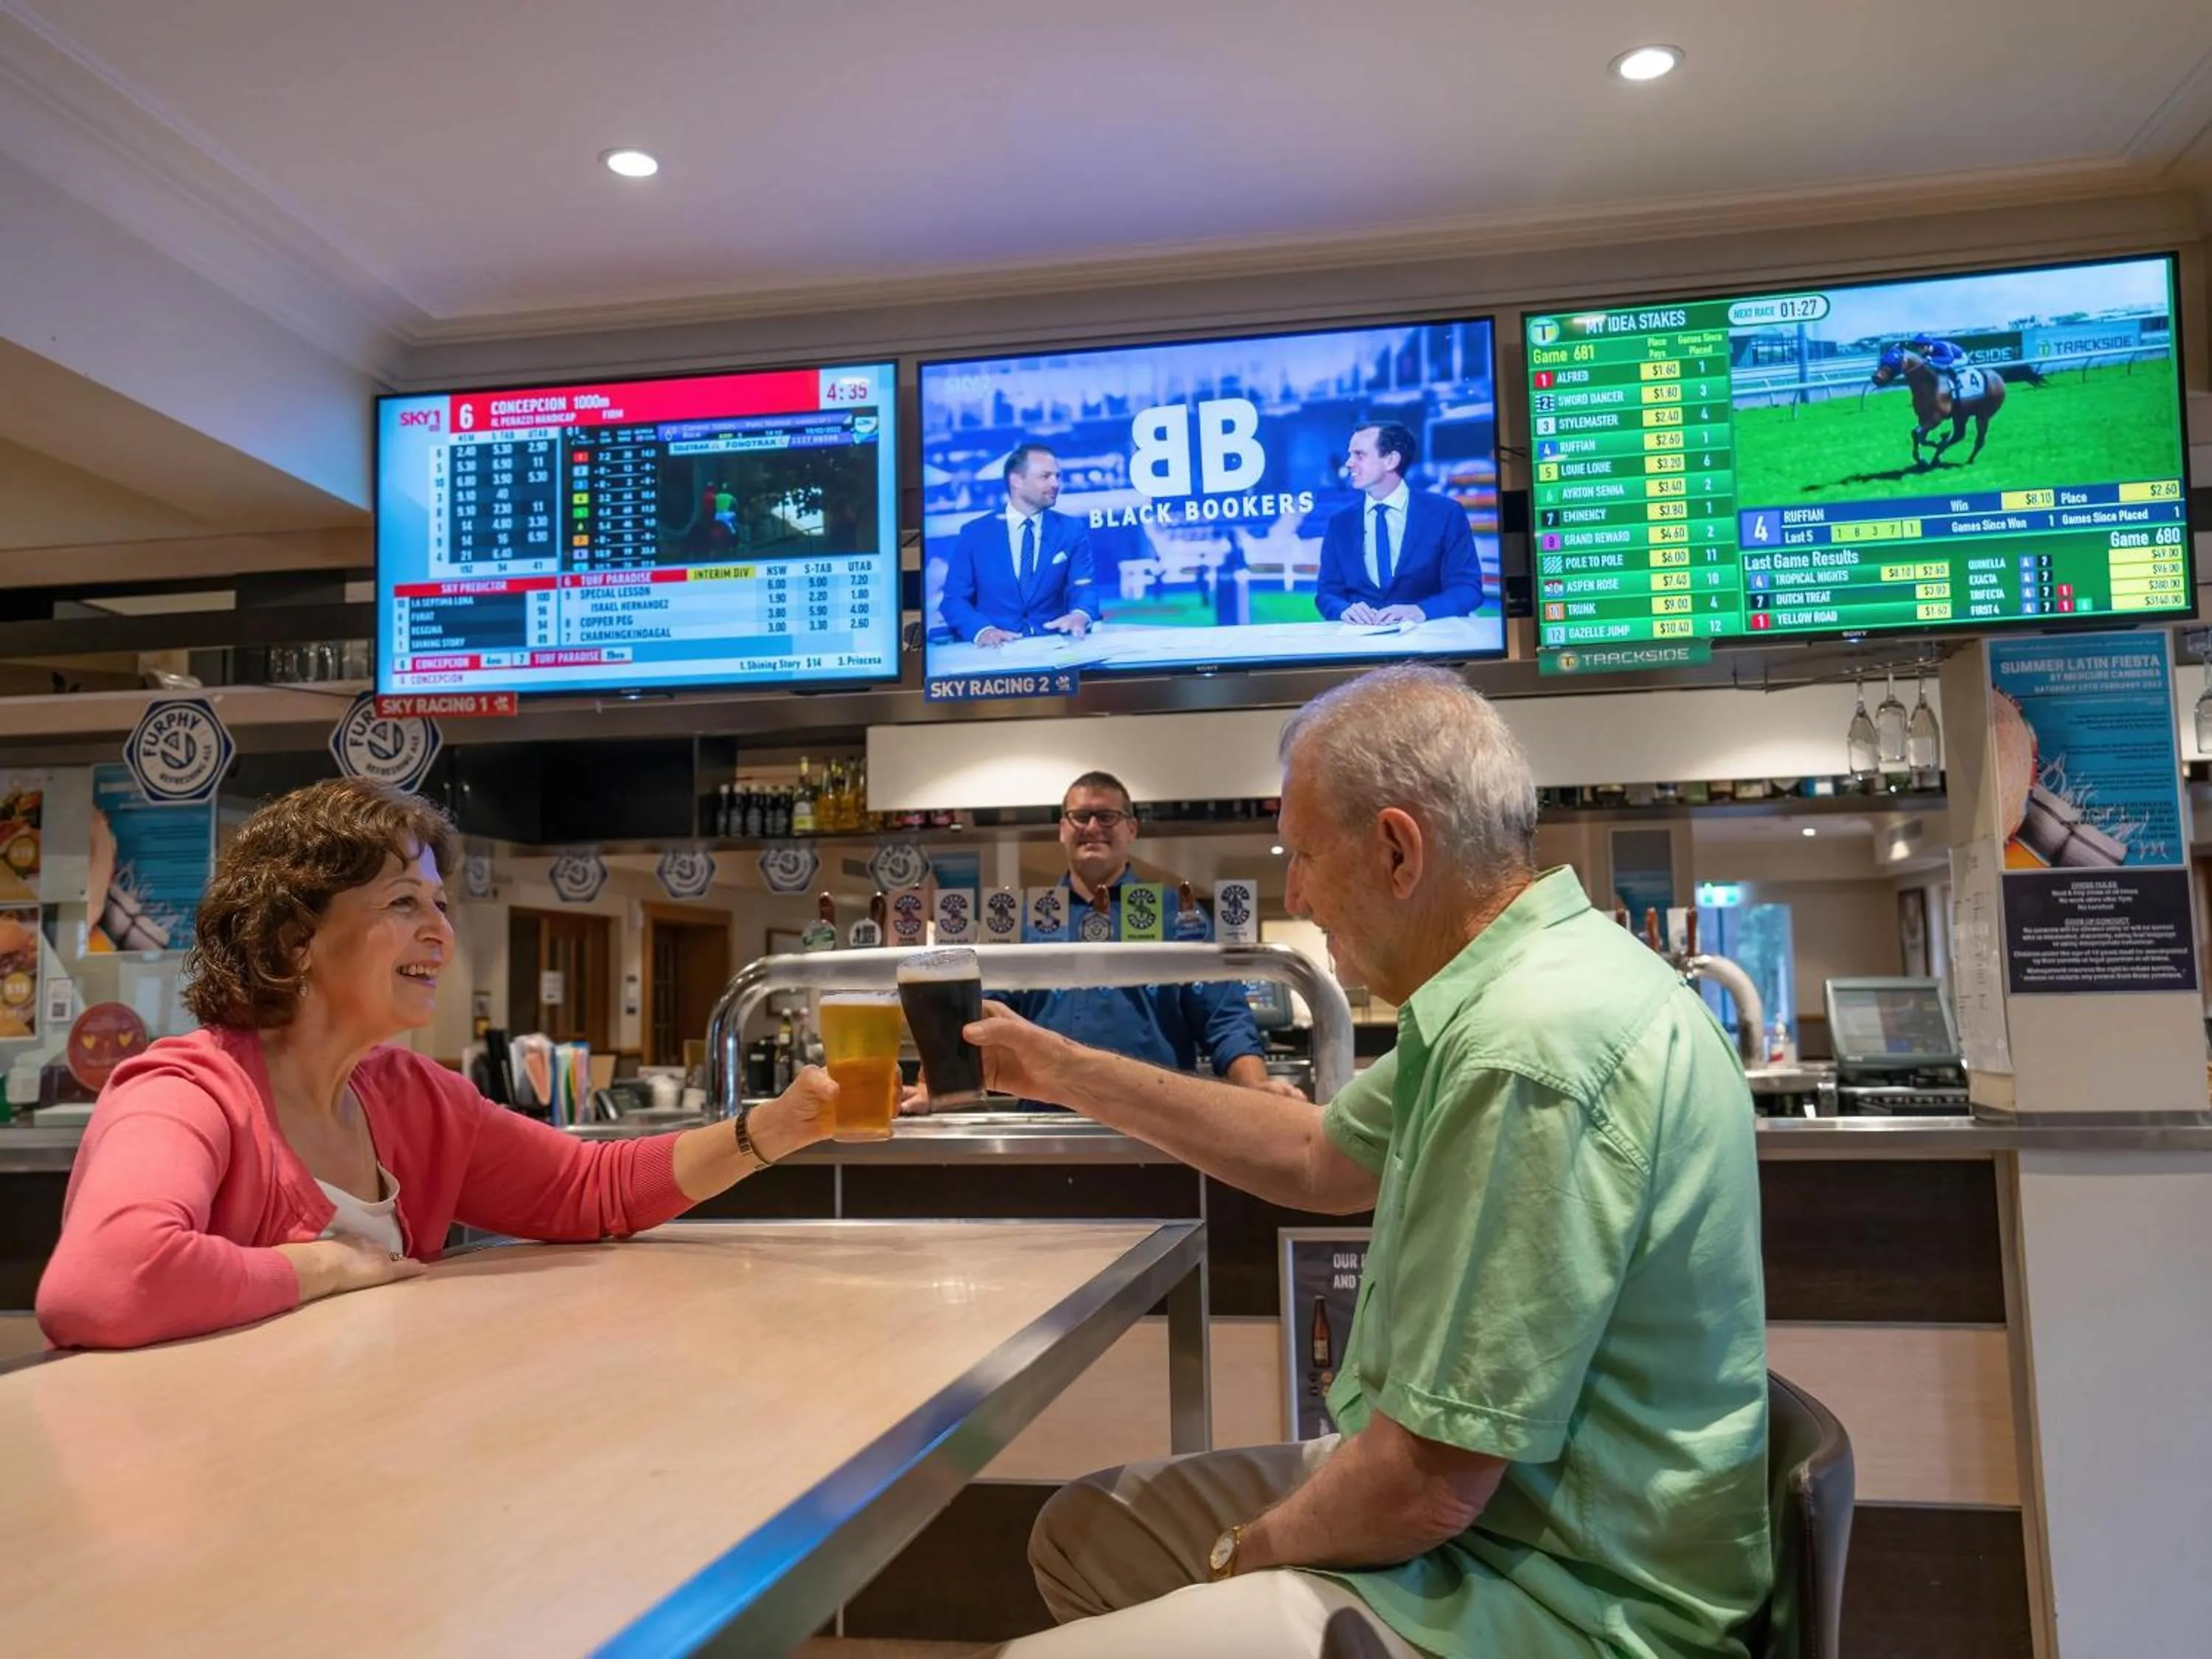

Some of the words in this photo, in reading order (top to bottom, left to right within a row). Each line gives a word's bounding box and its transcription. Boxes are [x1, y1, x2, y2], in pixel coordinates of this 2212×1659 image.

[1734, 308, 1753, 319] NEXT
[1754, 306, 1775, 317] RACE
[1781, 299, 1817, 318] 01:27
[1586, 316, 1604, 334] MY
[1608, 313, 1635, 331] IDEA
[1639, 310, 1686, 327] STAKES
[2053, 335, 2132, 356] TRACKSIDE
[1533, 349, 1568, 364] Game
[1573, 344, 1595, 360] 681
[1557, 370, 1589, 383] ALFRED
[1652, 364, 1676, 377] $1.60
[827, 382, 867, 401] 4:35
[1558, 392, 1588, 406] SWORD
[1590, 391, 1624, 403] DANCER
[1700, 384, 1707, 397] 3
[491, 397, 566, 415] CONCEPCION
[459, 404, 473, 428] 6
[1559, 414, 1618, 430] STYLEMASTER
[1559, 440, 1596, 453] RUFFIAN
[1561, 462, 1586, 476] LOUIE
[1562, 486, 1594, 499] AYRTON
[1595, 484, 1624, 497] SENNA
[1089, 502, 1172, 529] BLACK
[1185, 491, 1313, 523] BOOKERS
[1563, 508, 1606, 522] EMINENCY
[1754, 515, 1768, 543] 4
[1784, 508, 1824, 524] RUFFIAN
[1950, 499, 1969, 512] Win
[2061, 491, 2087, 504] Place
[2150, 483, 2177, 495] $2.60
[1785, 530, 1806, 544] Last
[1806, 529, 1813, 543] 5
[1952, 521, 1981, 533] Games
[1983, 519, 2007, 531] Since
[2008, 518, 2027, 529] Won
[2062, 514, 2091, 526] Games
[2093, 512, 2117, 523] Since
[2118, 509, 2149, 521] Placed
[1564, 533, 1593, 546] GRAND
[1595, 531, 1630, 544] REWARD
[2110, 531, 2149, 548] Game
[2155, 527, 2180, 544] 680
[1565, 555, 1586, 569] POLE
[1587, 554, 1600, 567] TO
[1601, 554, 1623, 566] POLE
[1745, 554, 1771, 571] Last
[1773, 552, 1809, 568] Game
[1812, 549, 1859, 566] Results
[581, 574, 603, 585] TURF
[606, 571, 652, 584] PARADISE
[733, 566, 749, 578] DIV
[766, 566, 787, 576] NSW
[804, 563, 832, 574] S-TAB
[848, 561, 872, 572] UTAB
[1775, 571, 1816, 586] TROPICAL
[1817, 570, 1848, 582] NIGHTS
[580, 588, 615, 599] SPECIAL
[618, 586, 650, 597] LESSON
[1567, 579, 1595, 593] ASPEN
[1596, 578, 1619, 590] ROSE
[591, 602, 619, 613] ISRAEL
[621, 599, 669, 611] HERNANDEZ
[1775, 593, 1804, 605] DUTCH
[1804, 591, 1831, 603] TREAT
[1568, 602, 1596, 616] TRUNK
[580, 616, 614, 627] COPPER
[616, 615, 633, 626] PEG
[1776, 612, 1812, 625] YELLOW
[1813, 611, 1837, 622] ROAD
[1568, 627, 1605, 639] GAZELLE
[1607, 625, 1630, 638] JUMP
[557, 650, 599, 663] PARADISE
[747, 659, 777, 671] Shining
[779, 658, 801, 670] Story
[1582, 647, 1690, 667] TRACKSIDE
[2001, 659, 2064, 675] SUMMER
[2067, 657, 2108, 671] LATIN
[2112, 654, 2160, 668] FIESTA
[931, 680, 963, 698] SKY
[970, 677, 1034, 695] RACING
[1038, 676, 1049, 692] 2
[382, 700, 414, 714] SKY
[416, 698, 476, 713] RACING
[480, 697, 487, 712] 1
[143, 712, 202, 757] FURPHY
[1333, 1253, 1357, 1269] OUR
[1333, 1274, 1356, 1289] AND
